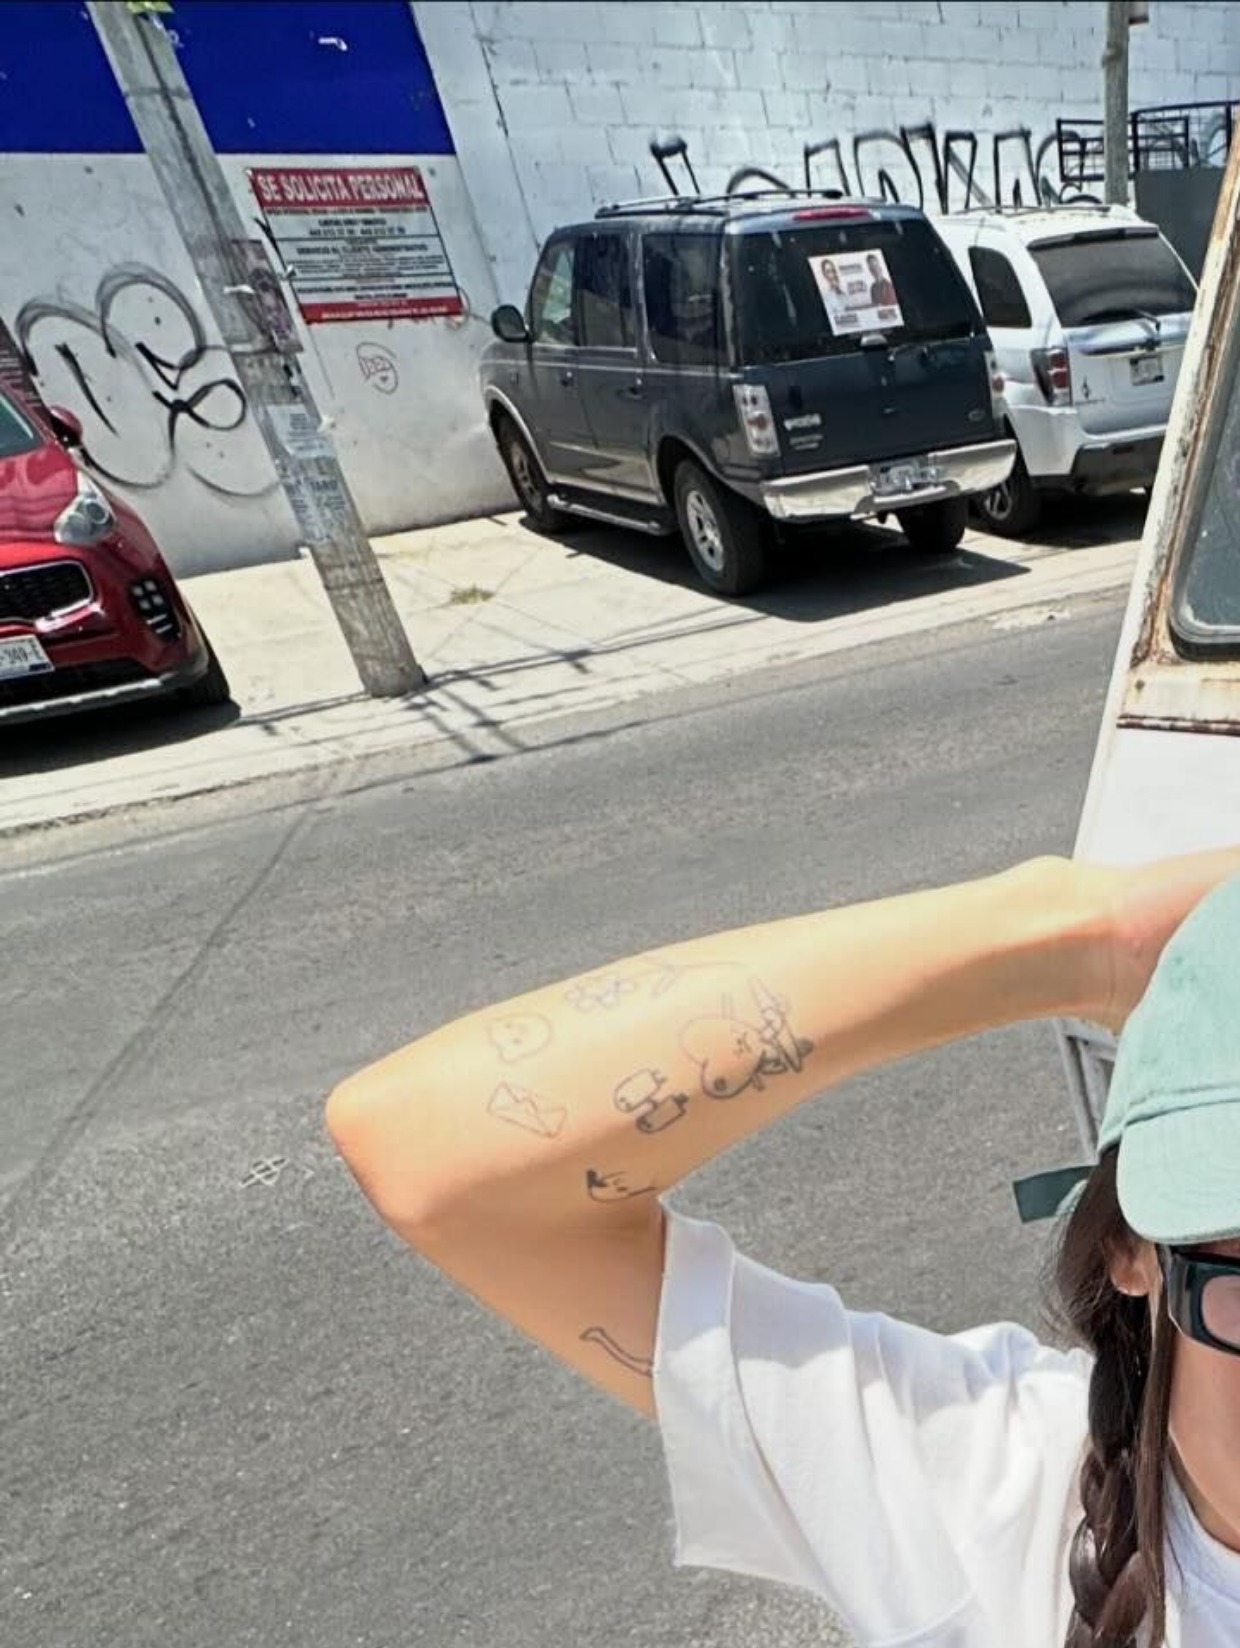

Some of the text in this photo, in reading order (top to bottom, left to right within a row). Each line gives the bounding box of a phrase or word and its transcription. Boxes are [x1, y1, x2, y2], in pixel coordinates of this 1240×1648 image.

[257, 173, 425, 202] SE SOLICITA PERSONAL
